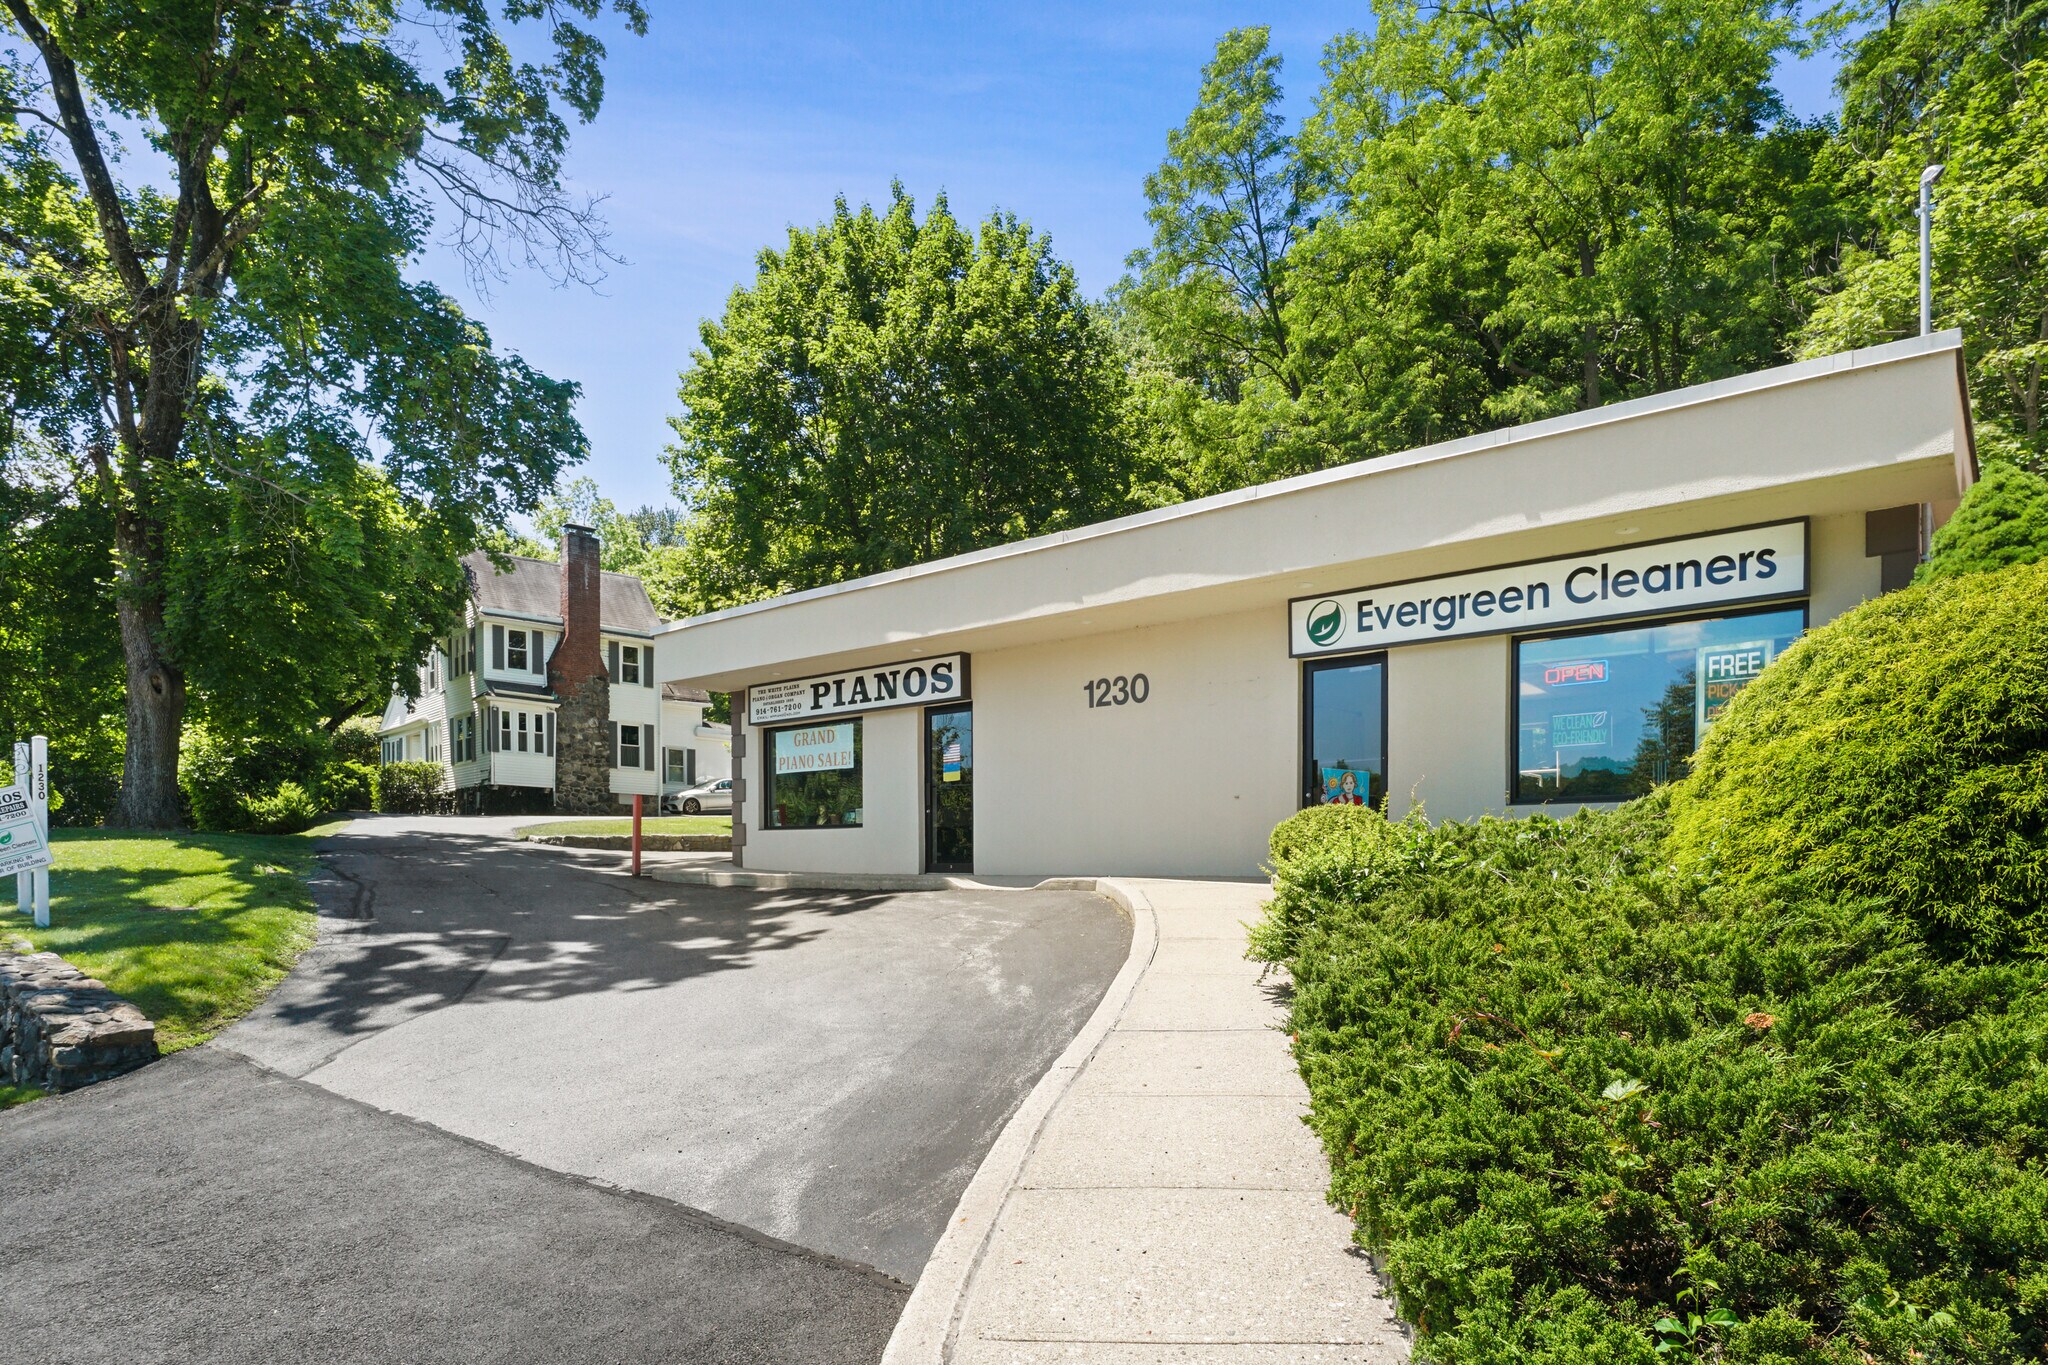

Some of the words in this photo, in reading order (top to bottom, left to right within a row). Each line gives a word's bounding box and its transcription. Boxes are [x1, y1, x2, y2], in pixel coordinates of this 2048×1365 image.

[1357, 581, 1550, 631] Evergreen
[1565, 548, 1777, 604] Cleaners
[1545, 664, 1604, 684] OPEN
[1708, 651, 1761, 678] FREE
[784, 690, 806, 698] COMPANY
[810, 662, 953, 710] PIANOS
[1083, 673, 1149, 708] 1230
[755, 703, 802, 716] 914-761-7200
[1553, 716, 1565, 731] WE
[1566, 714, 1593, 729] CLEAN
[794, 729, 835, 747] GRAND
[1552, 729, 1608, 745] ECO-FRIENDLY
[779, 754, 815, 771] PIANO
[817, 751, 851, 768] SALE!
[38, 764, 46, 800] 1230
[0, 791, 22, 805] OS
[17, 857, 47, 868] BUILDING
